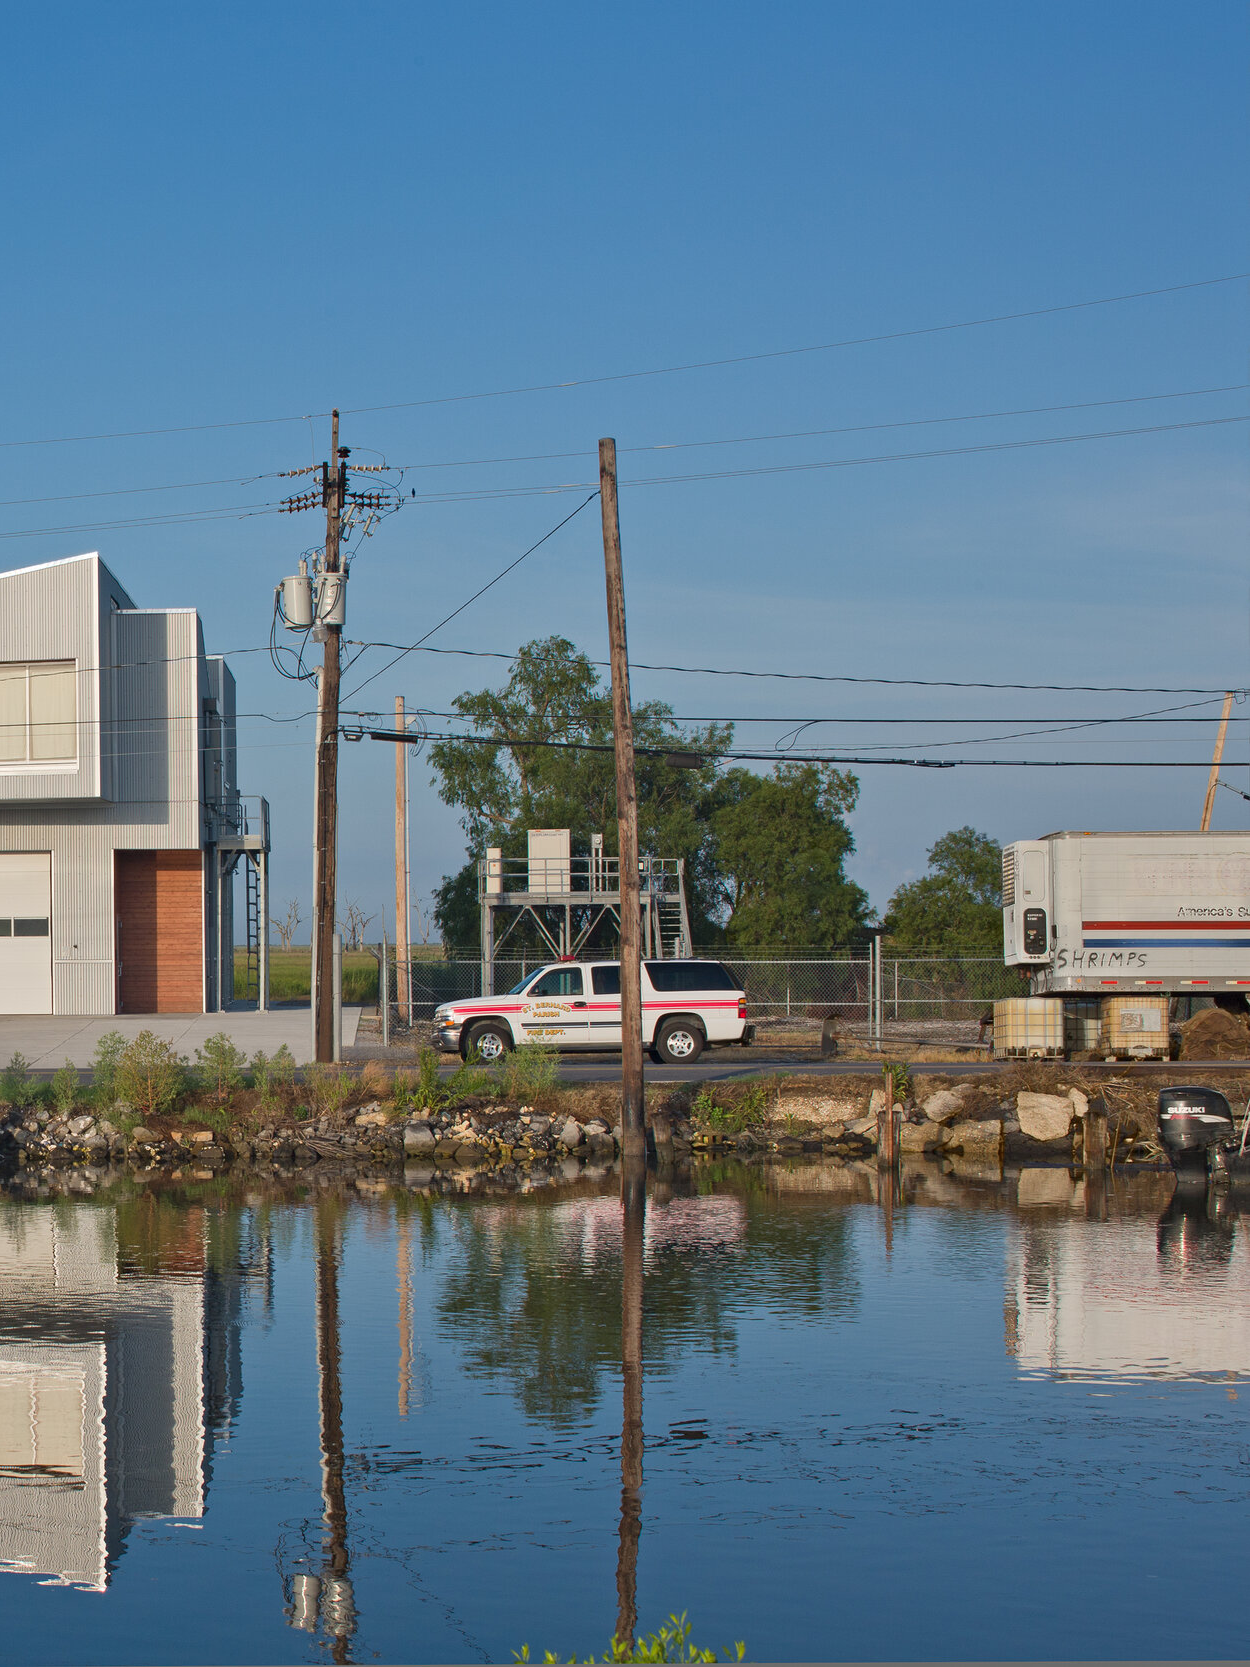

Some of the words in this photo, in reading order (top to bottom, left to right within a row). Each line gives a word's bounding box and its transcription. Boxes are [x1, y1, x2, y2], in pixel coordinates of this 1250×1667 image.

[1177, 906, 1233, 917] America's
[1057, 948, 1148, 969] SHRIMPS
[522, 1005, 534, 1013] ST.
[535, 1002, 571, 1012] BERNARD
